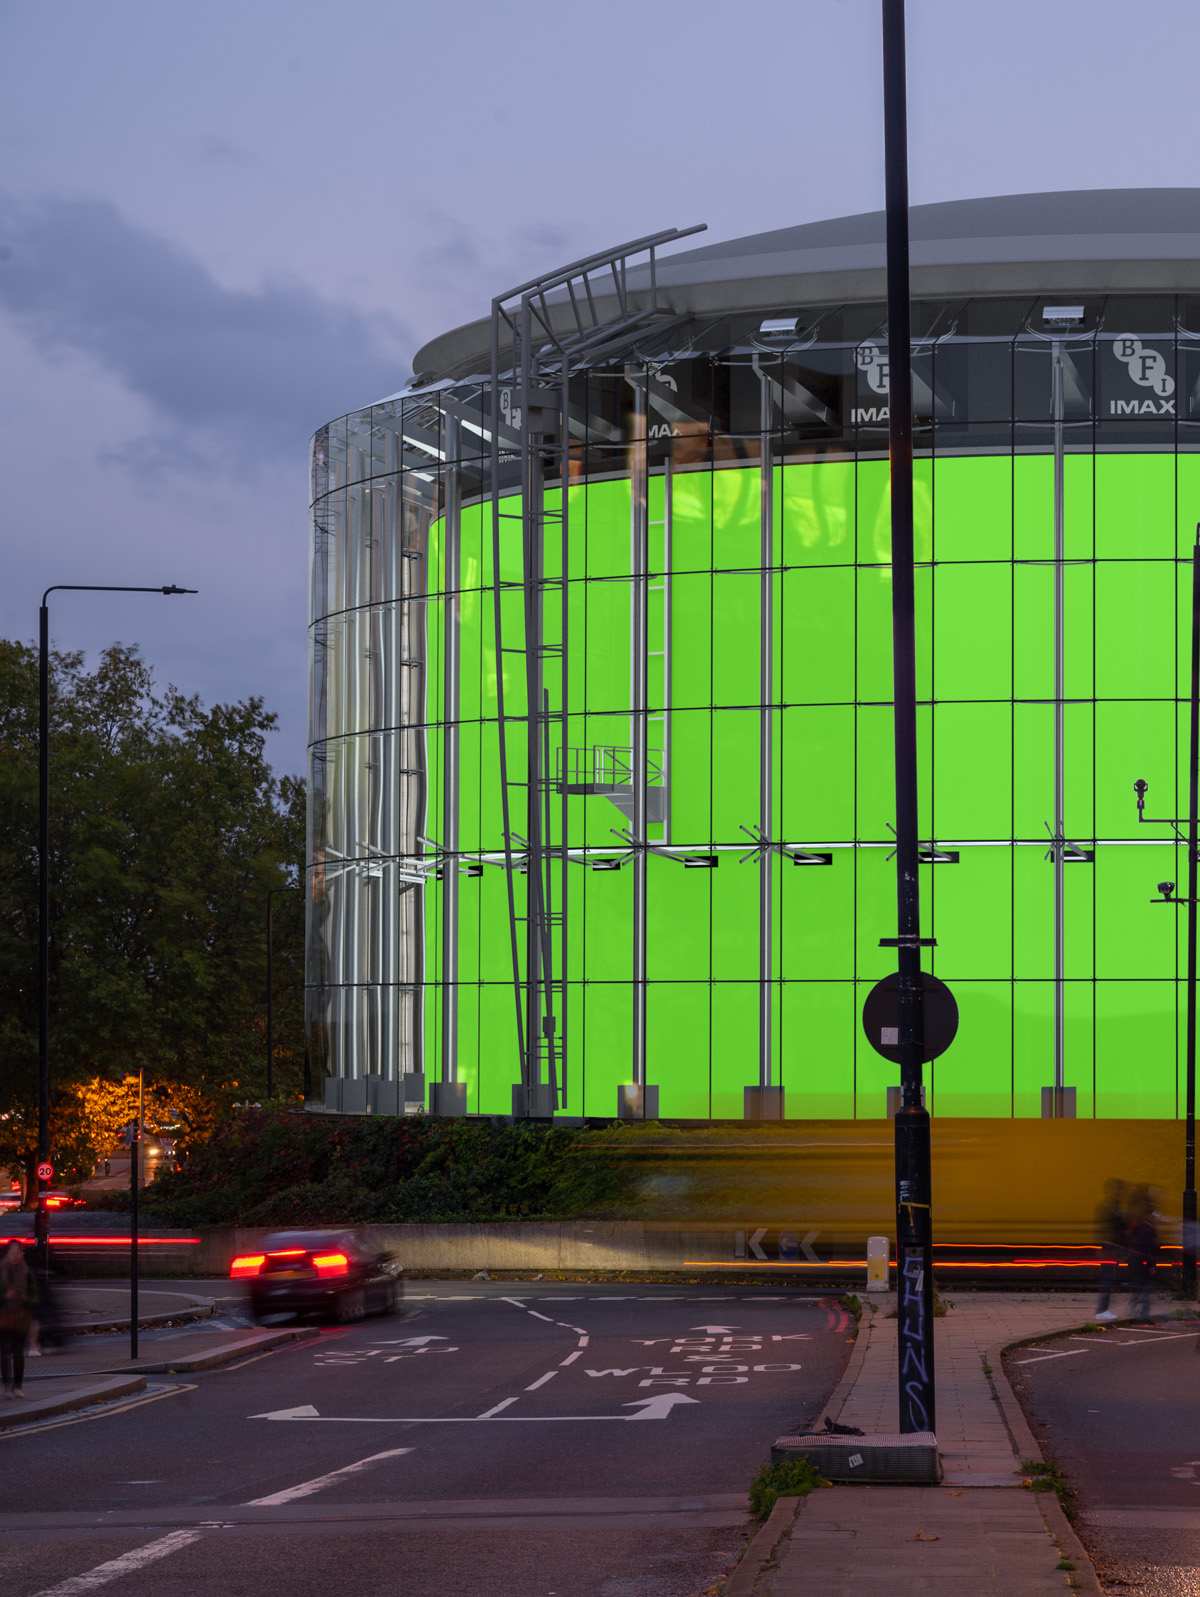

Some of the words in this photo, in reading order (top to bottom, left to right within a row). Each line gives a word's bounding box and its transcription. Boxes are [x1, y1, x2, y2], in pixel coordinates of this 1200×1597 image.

[1119, 337, 1168, 394] BFI
[1110, 400, 1176, 414] IMAX
[850, 407, 890, 423] IMA
[39, 1167, 52, 1176] 20
[630, 1333, 814, 1346] YORK
[669, 1344, 762, 1353] RD
[314, 1355, 417, 1366] ST
[682, 1354, 744, 1362] &
[638, 1376, 749, 1387] RD
